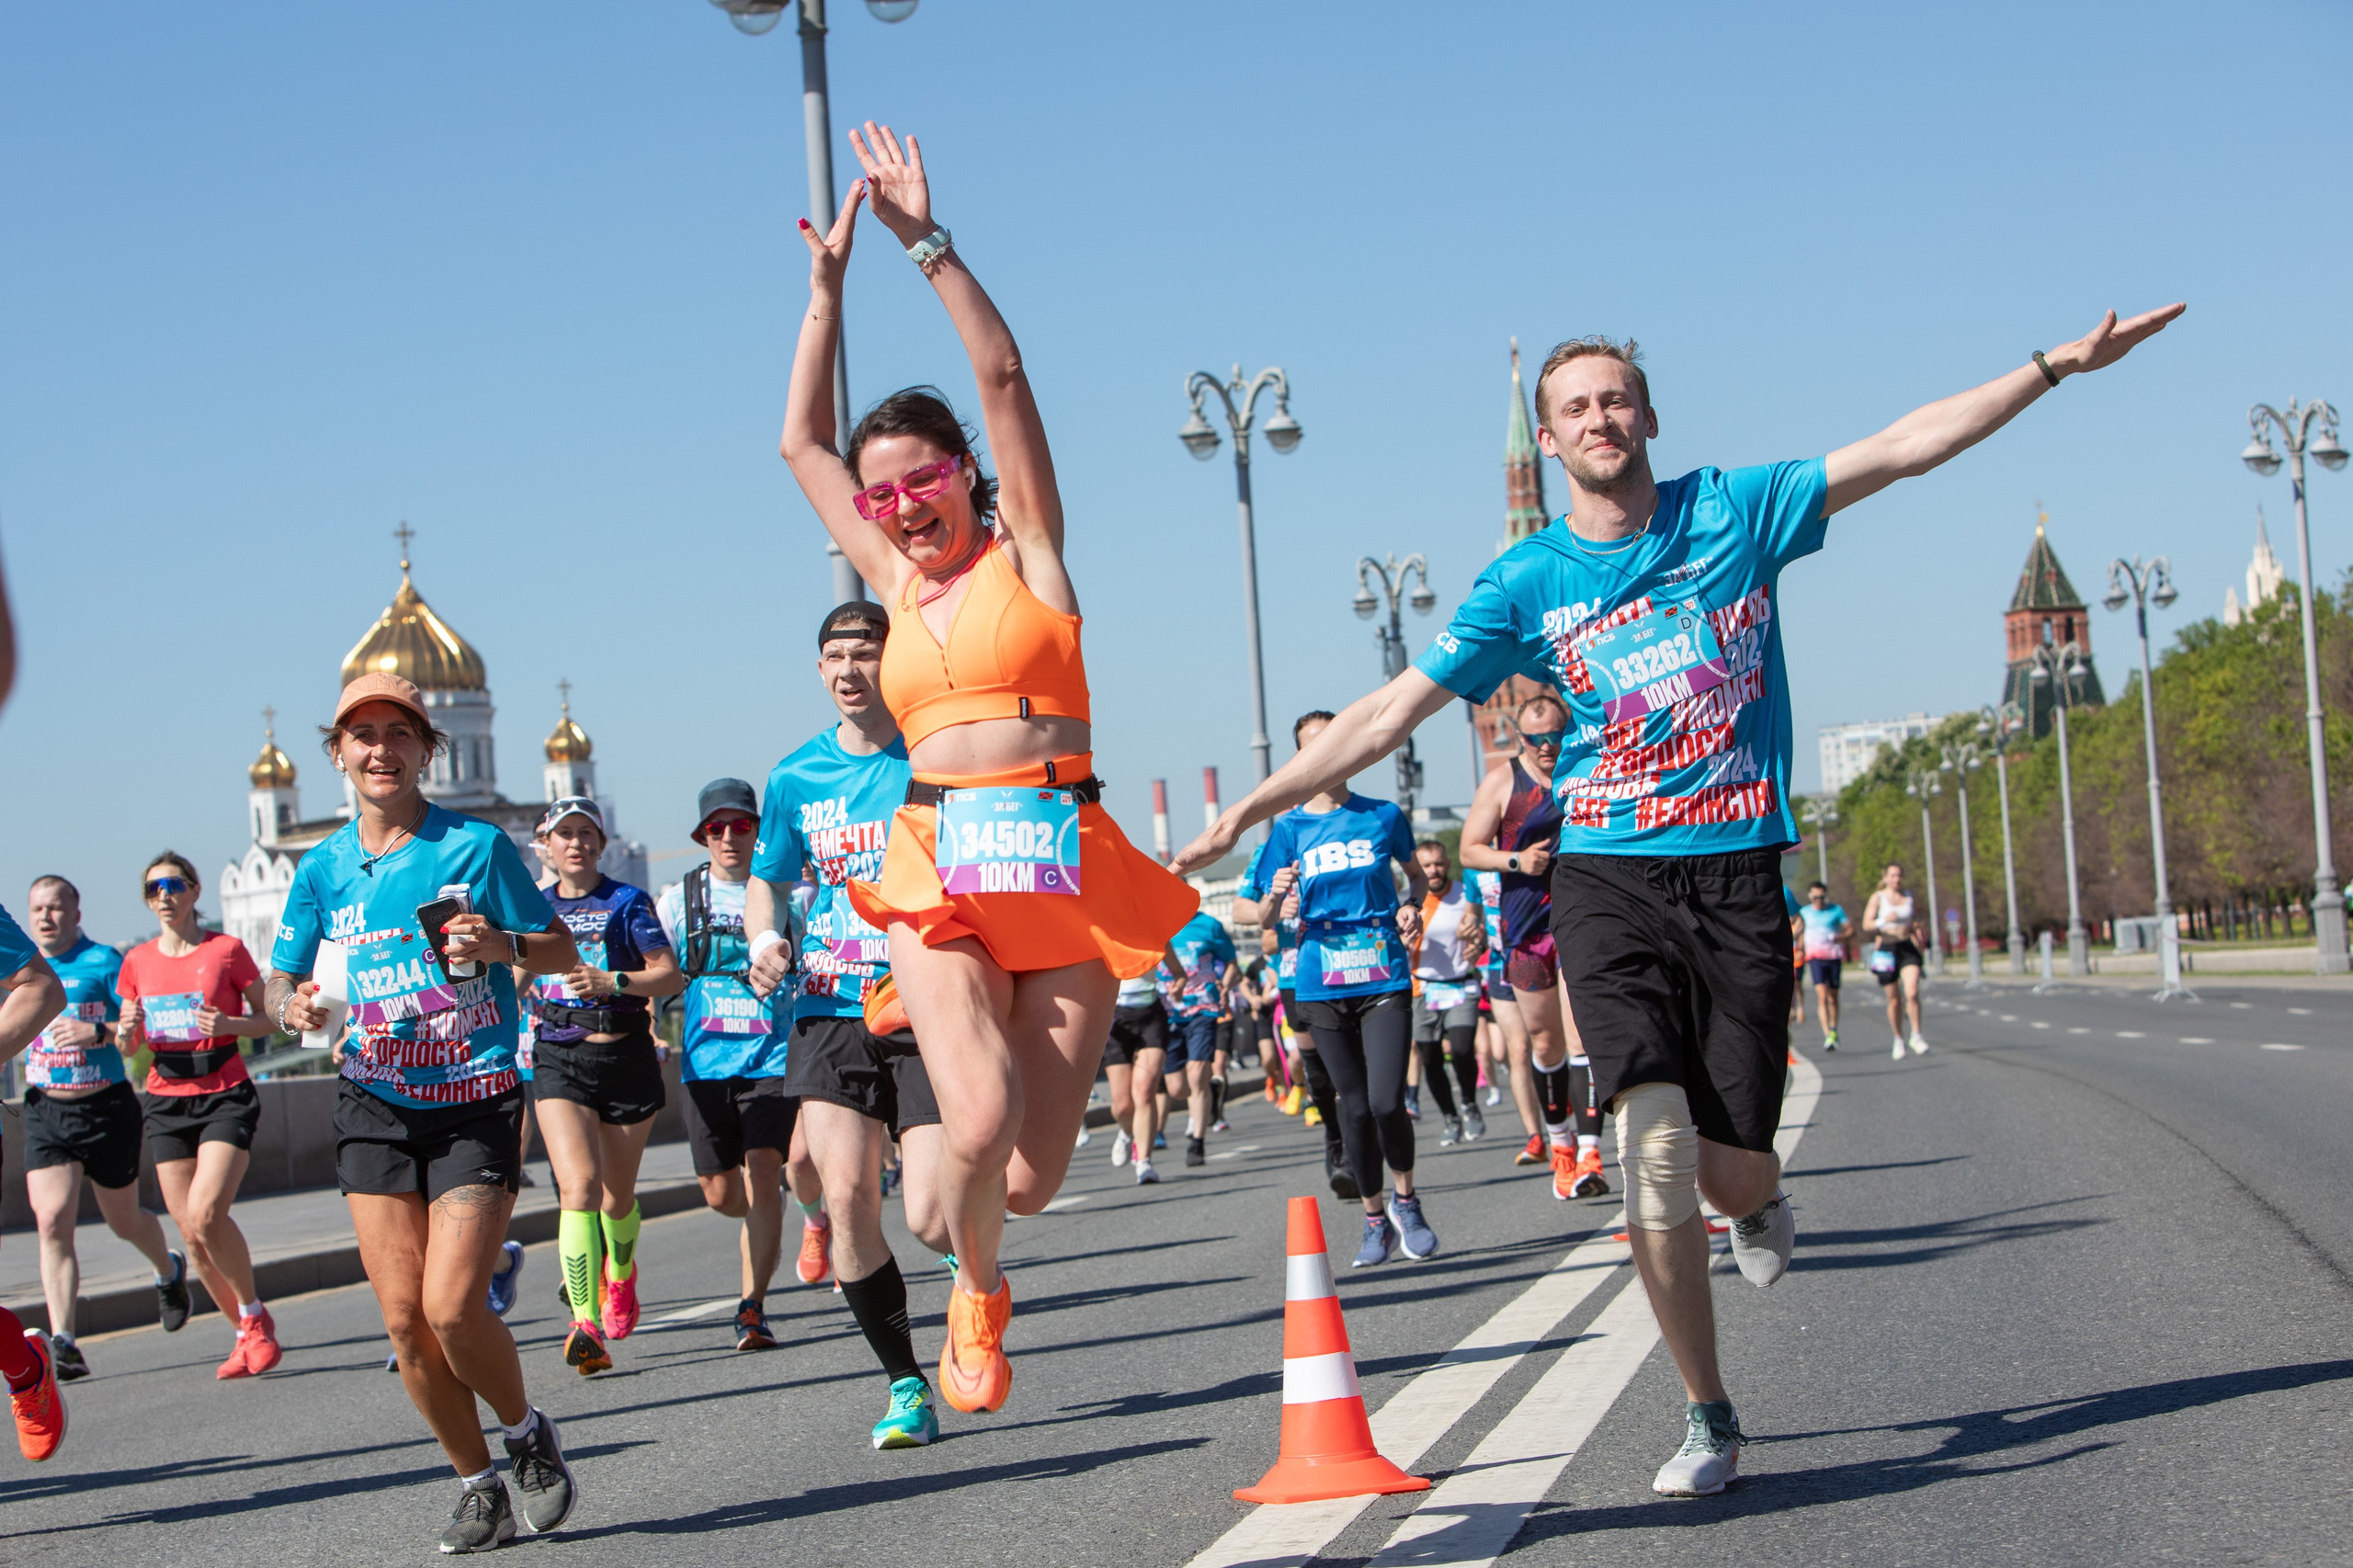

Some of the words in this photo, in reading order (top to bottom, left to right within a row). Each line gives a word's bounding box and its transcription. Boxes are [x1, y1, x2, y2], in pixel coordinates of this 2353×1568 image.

[1597, 633, 1616, 646] ПСБ
[1681, 617, 1691, 630] D
[1434, 631, 1461, 653] СБ
[1612, 632, 1698, 689] 33262
[1707, 742, 1758, 789] 2024
[956, 792, 977, 803] ПСБ
[1635, 777, 1778, 831] #ЕДИНСТВО
[801, 796, 848, 834] 2024
[754, 838, 767, 856] СБ
[809, 820, 886, 861] #МЕЧТА
[961, 821, 1054, 859] 34502
[845, 850, 886, 884] 202
[1302, 839, 1376, 880] IBS
[278, 922, 295, 941] СБ
[330, 902, 367, 938] 2024
[559, 913, 608, 925] ОСТО
[1333, 948, 1377, 970] 30566
[357, 958, 426, 1000] 32244
[153, 1007, 194, 1028] 32804
[415, 995, 503, 1040] #МОМЕНТ
[714, 997, 758, 1017] 36190
[358, 1034, 472, 1068] #ГОРДОСТЬ
[392, 1067, 518, 1103] #ЕДИНСТВО
